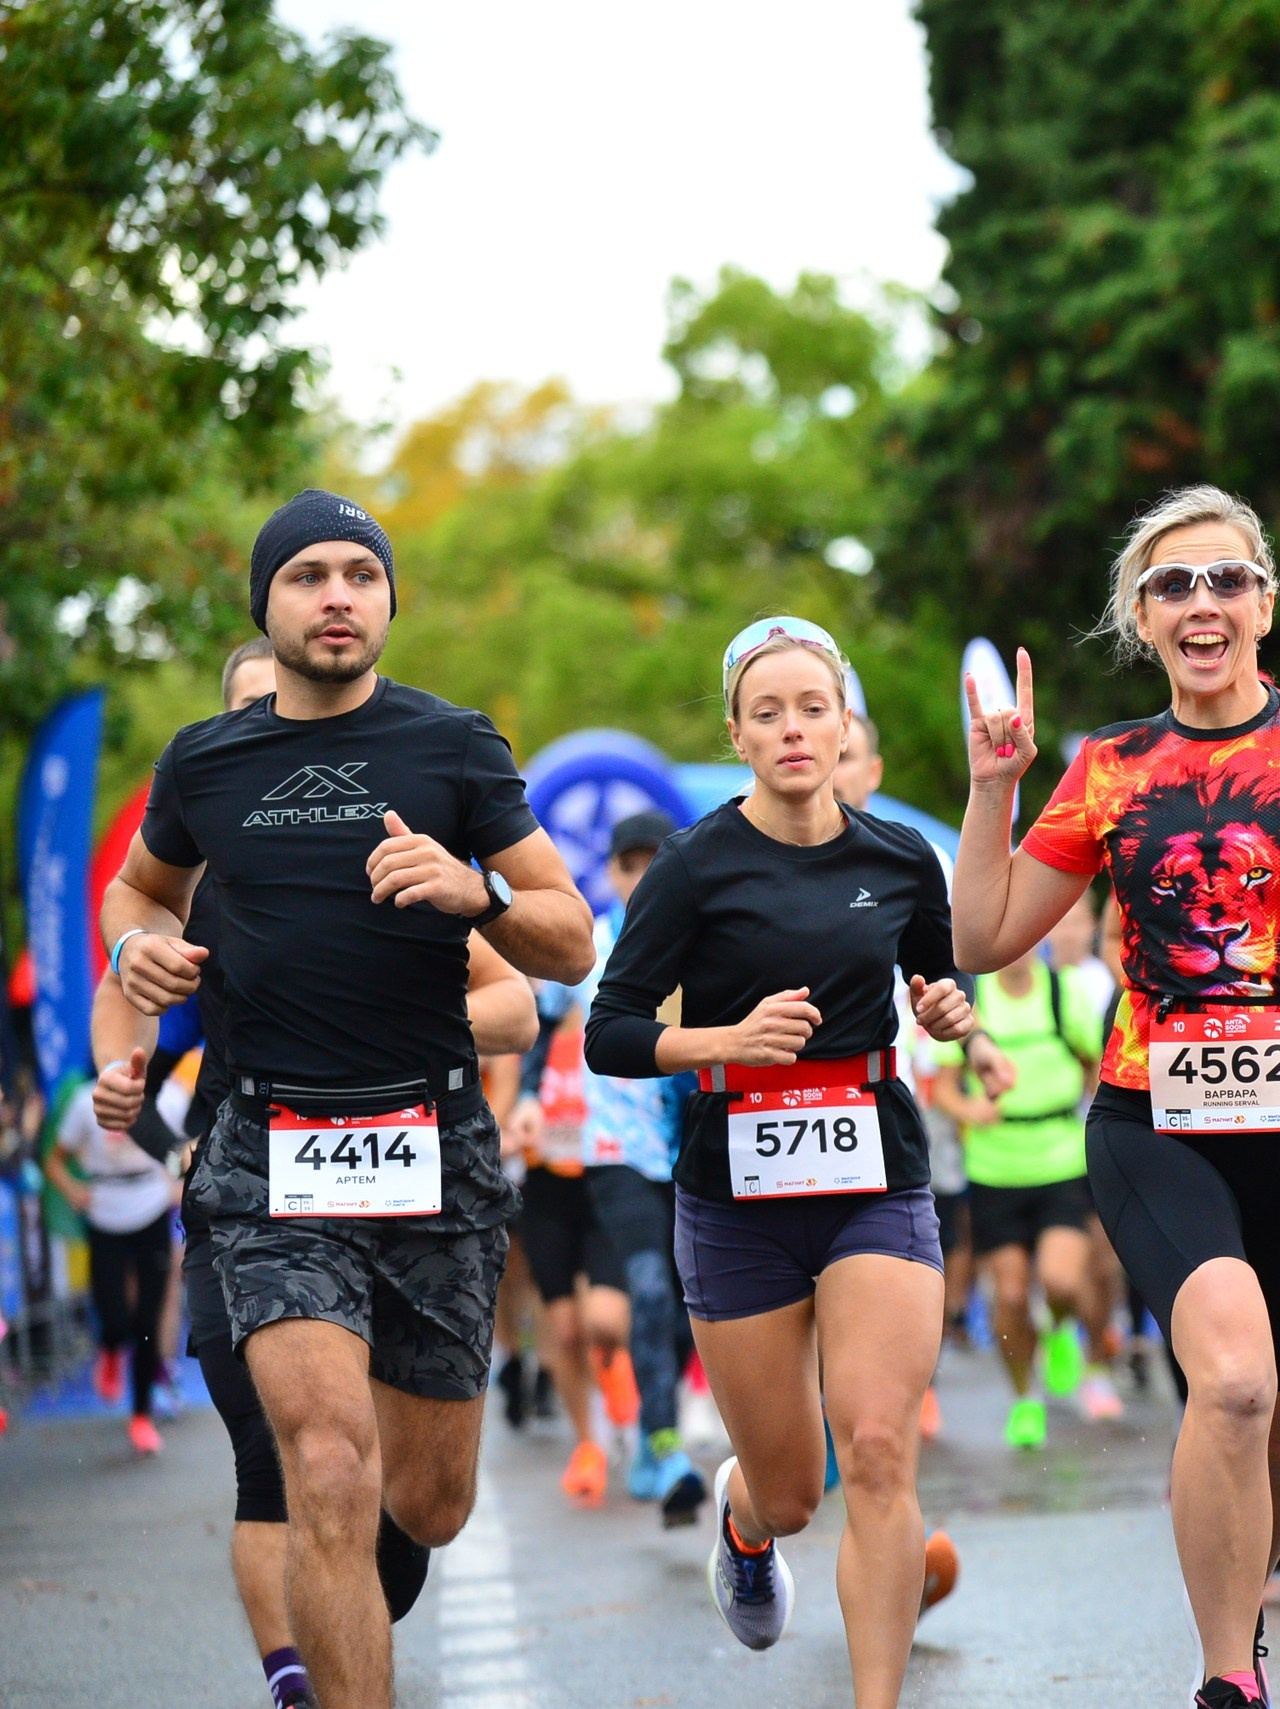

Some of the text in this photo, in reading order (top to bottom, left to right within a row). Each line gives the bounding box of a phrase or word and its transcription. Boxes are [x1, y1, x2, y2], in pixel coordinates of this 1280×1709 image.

[242, 802, 389, 827] ATHLEX
[1172, 1021, 1185, 1032] 10
[749, 1092, 763, 1104] 10
[1204, 1089, 1258, 1099] ВАРВАРА
[756, 1117, 858, 1158] 5718
[294, 1131, 416, 1170] 4414
[336, 1175, 376, 1184] АРТЕМ
